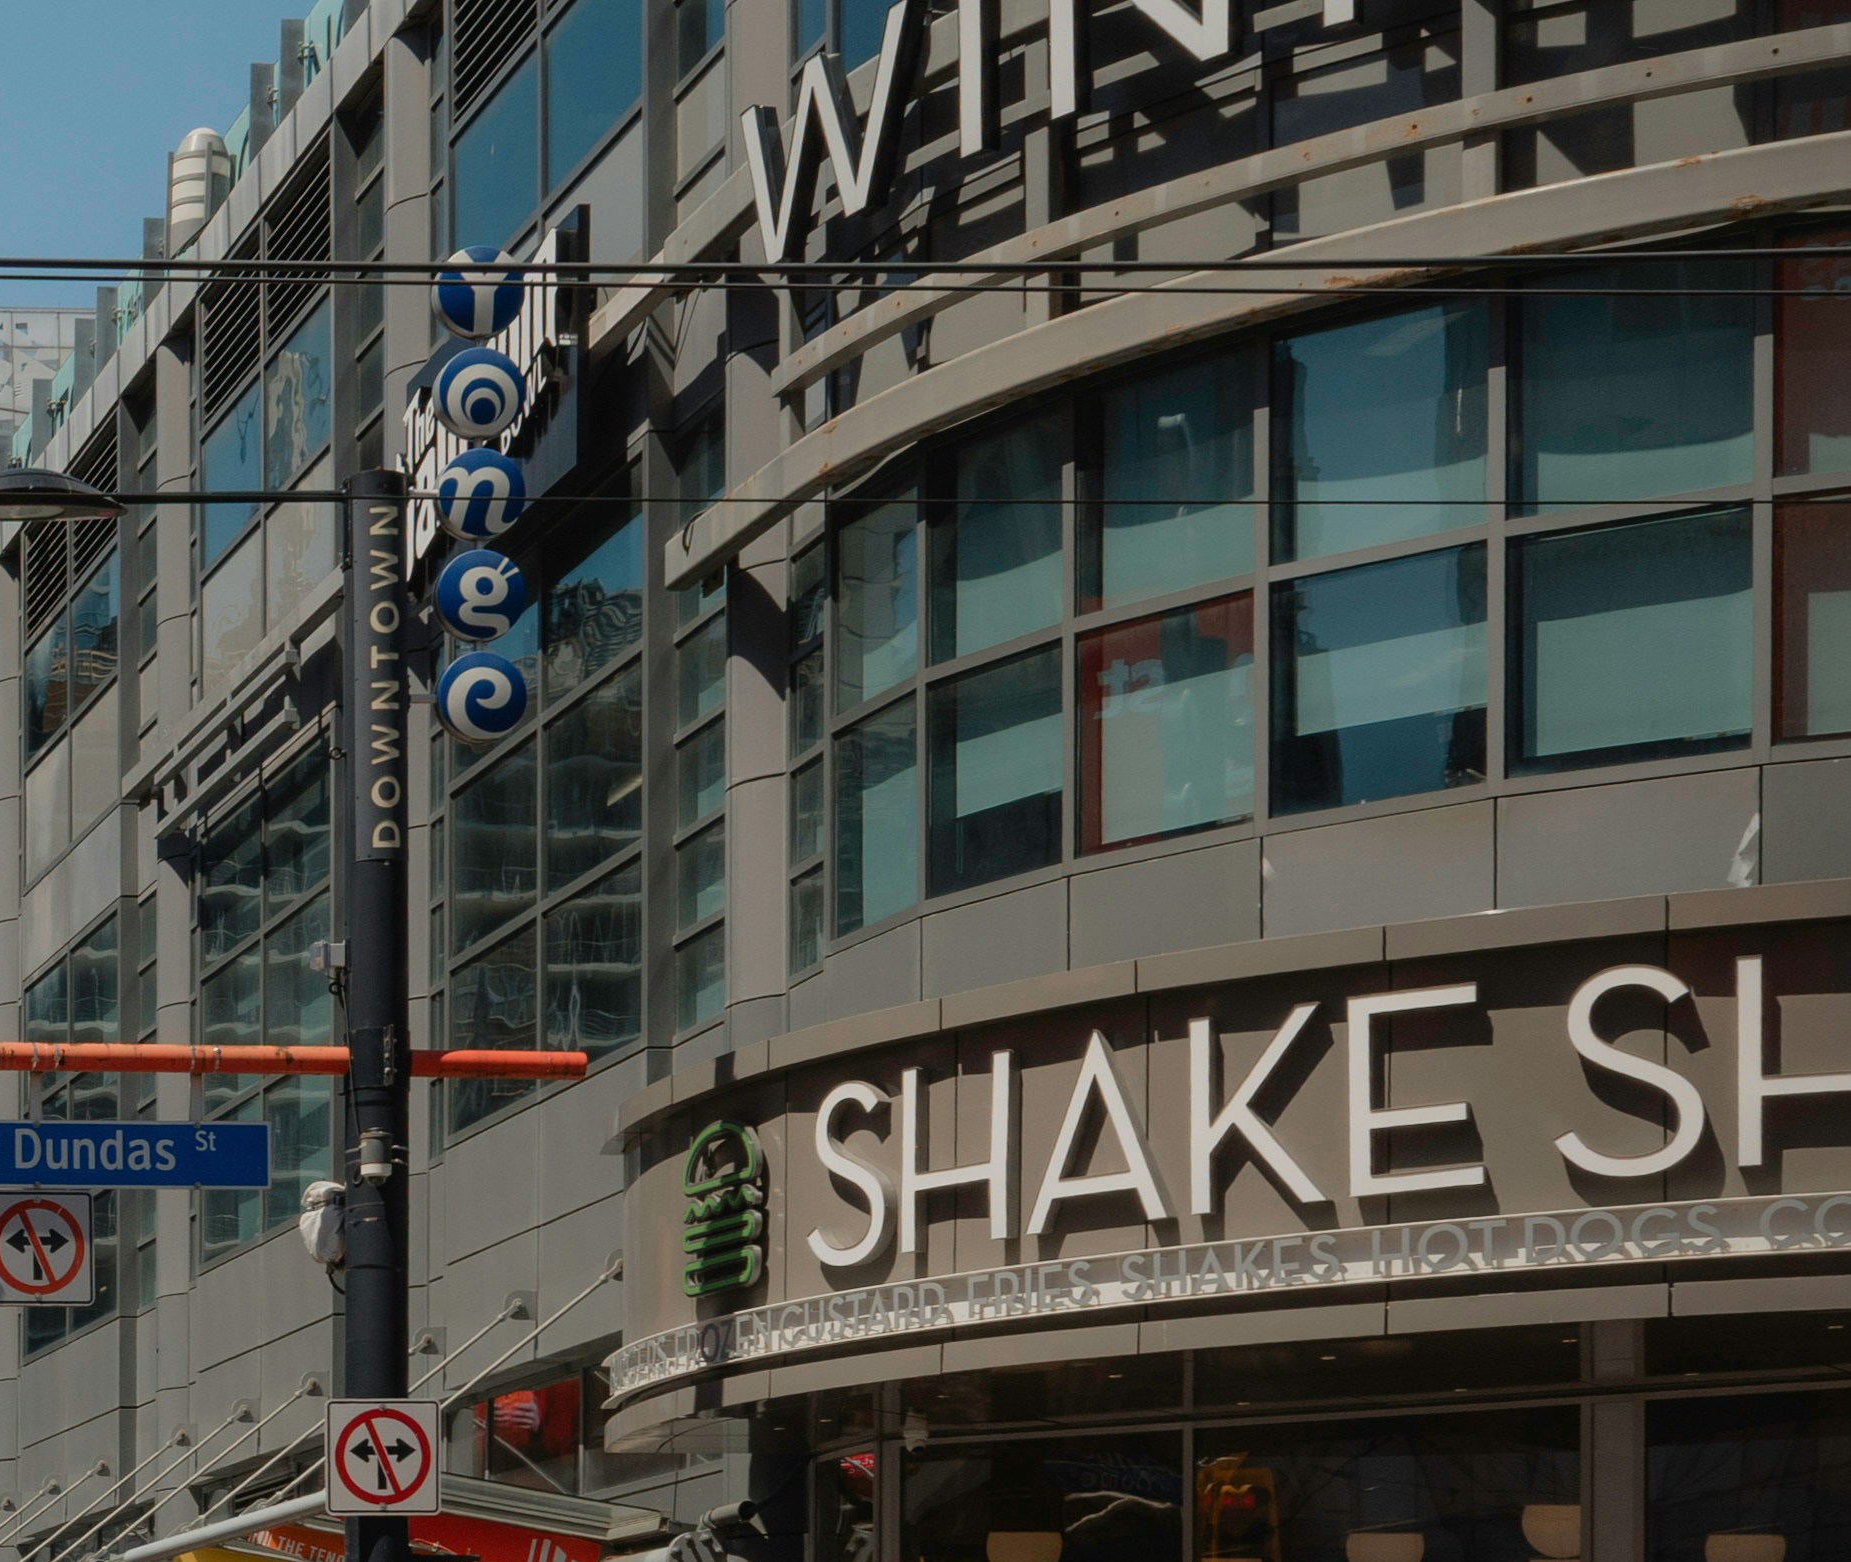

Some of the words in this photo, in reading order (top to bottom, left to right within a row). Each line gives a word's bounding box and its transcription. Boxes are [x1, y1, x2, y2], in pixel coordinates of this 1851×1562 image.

[741, 0, 1354, 264] WIN
[403, 387, 436, 471] The
[436, 247, 526, 742] Yonge
[369, 505, 401, 849] DOWNTOWN
[14, 1128, 176, 1171] Dundas
[195, 1130, 216, 1152] St
[806, 981, 1488, 1267] SHAKE
[675, 1310, 772, 1372] FROZEN
[779, 1283, 947, 1347] CUSTARD
[967, 1261, 1094, 1318] FRIES
[1120, 1233, 1341, 1301] SHAKES
[1372, 1218, 1506, 1277] HOT
[1524, 1203, 1724, 1265] DOGS
[278, 1535, 303, 1555] THE
